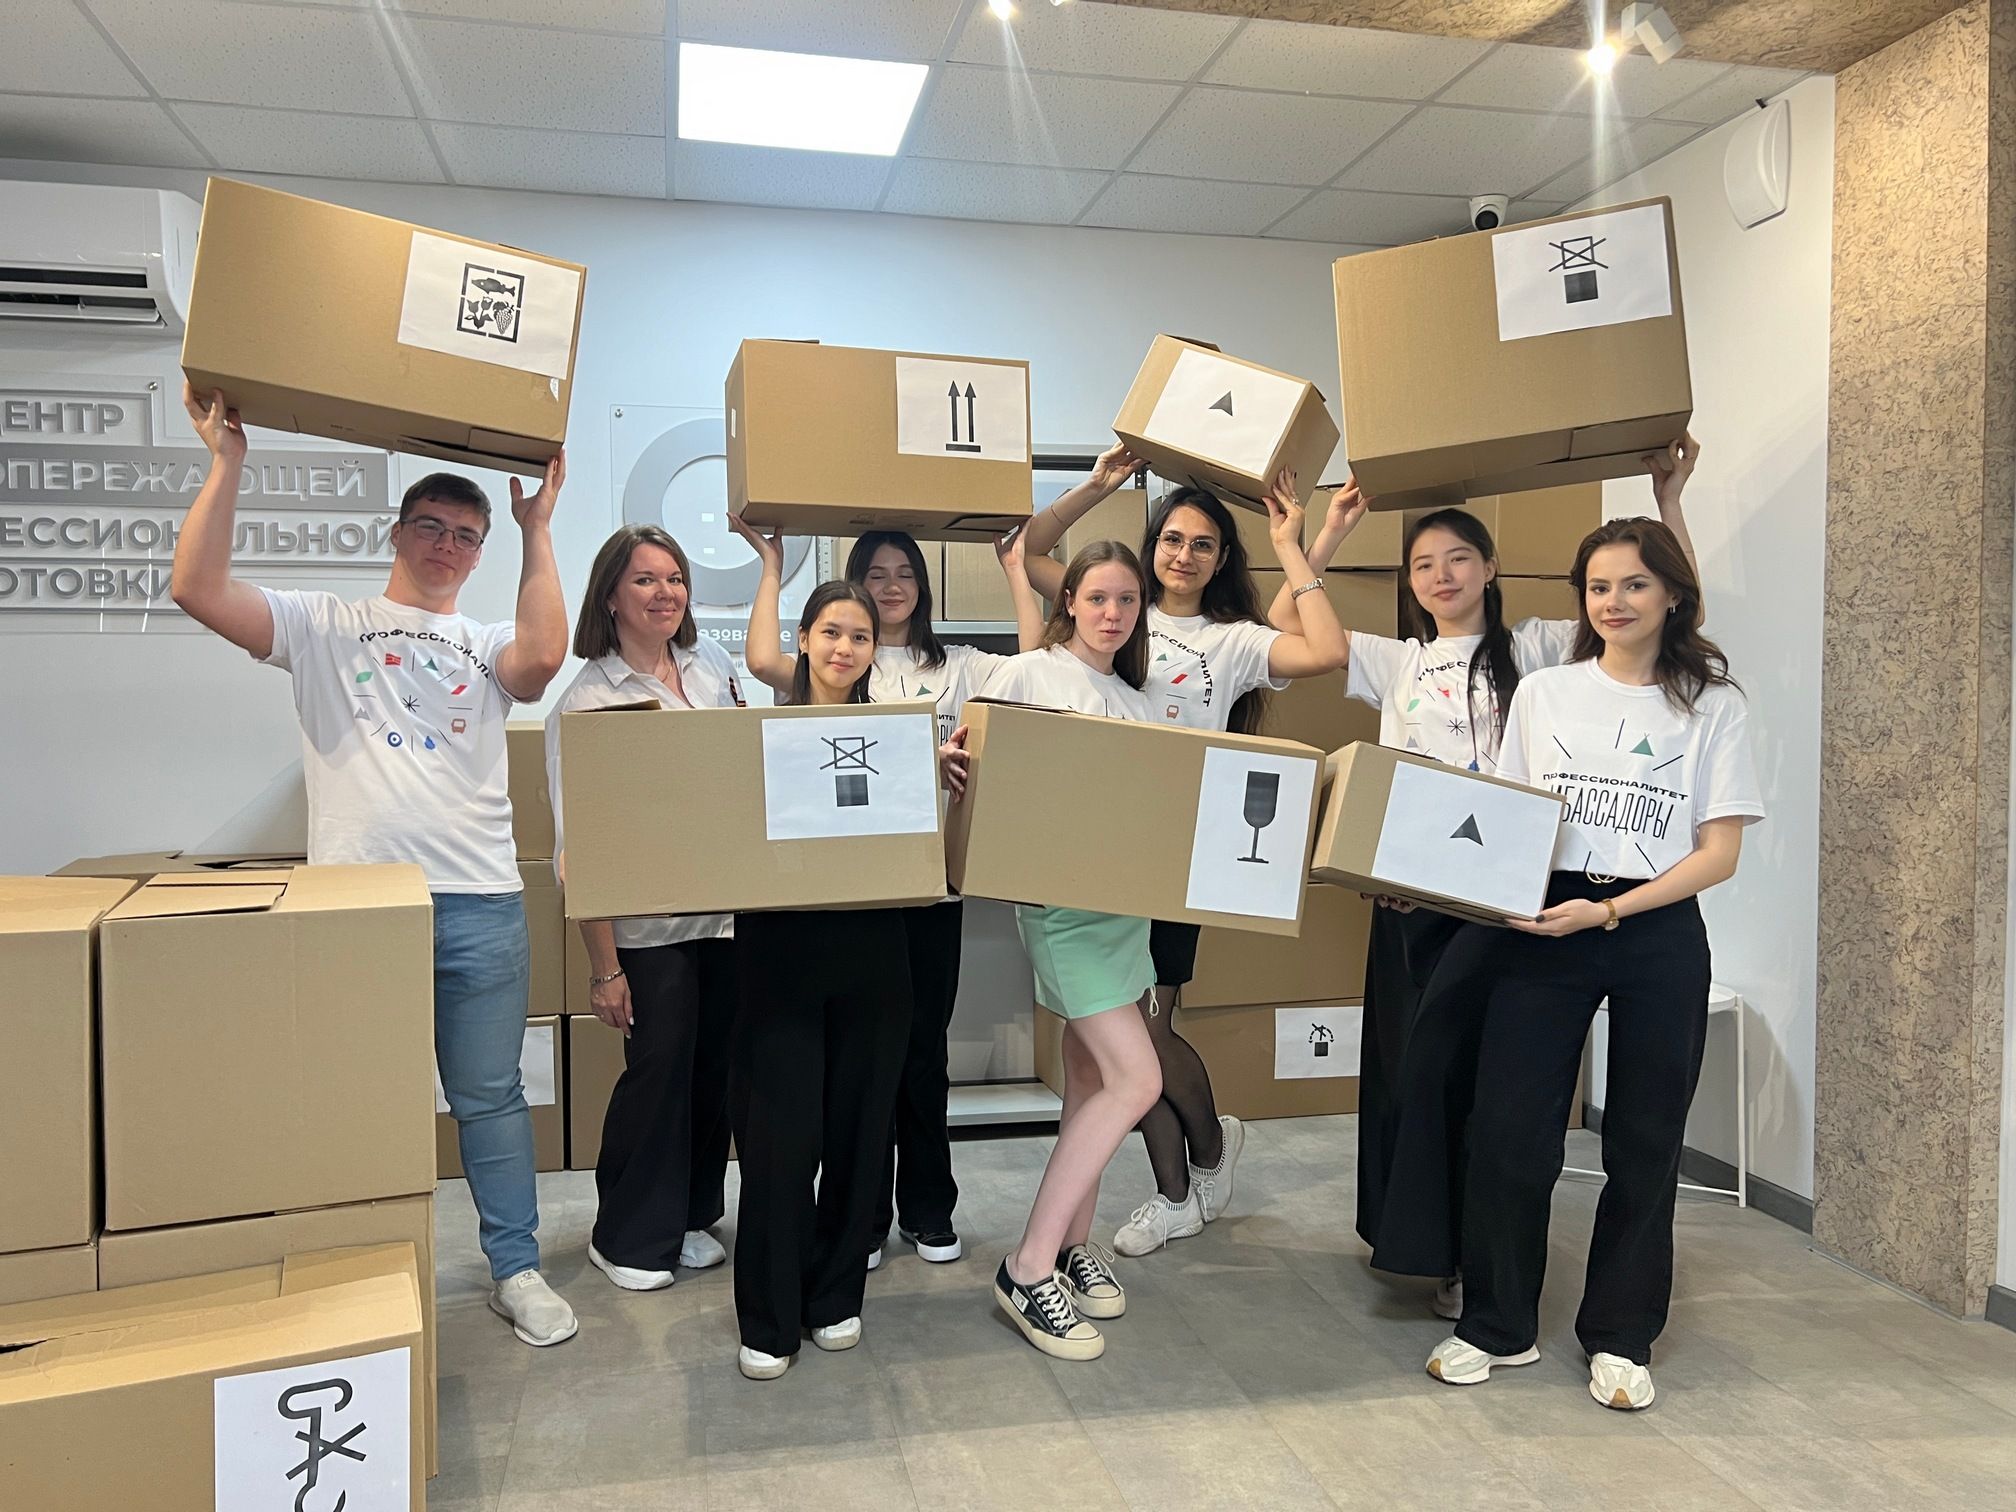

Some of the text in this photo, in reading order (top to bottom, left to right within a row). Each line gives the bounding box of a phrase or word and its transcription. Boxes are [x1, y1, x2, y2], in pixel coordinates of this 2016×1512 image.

[0, 400, 125, 435] ЕНТР
[0, 456, 367, 501] ПЕРЕЖАЩЕЙ
[1146, 630, 1213, 708] ЕССИОНАЛИТЕТ
[1551, 784, 1674, 840] БАССАДОРЫ
